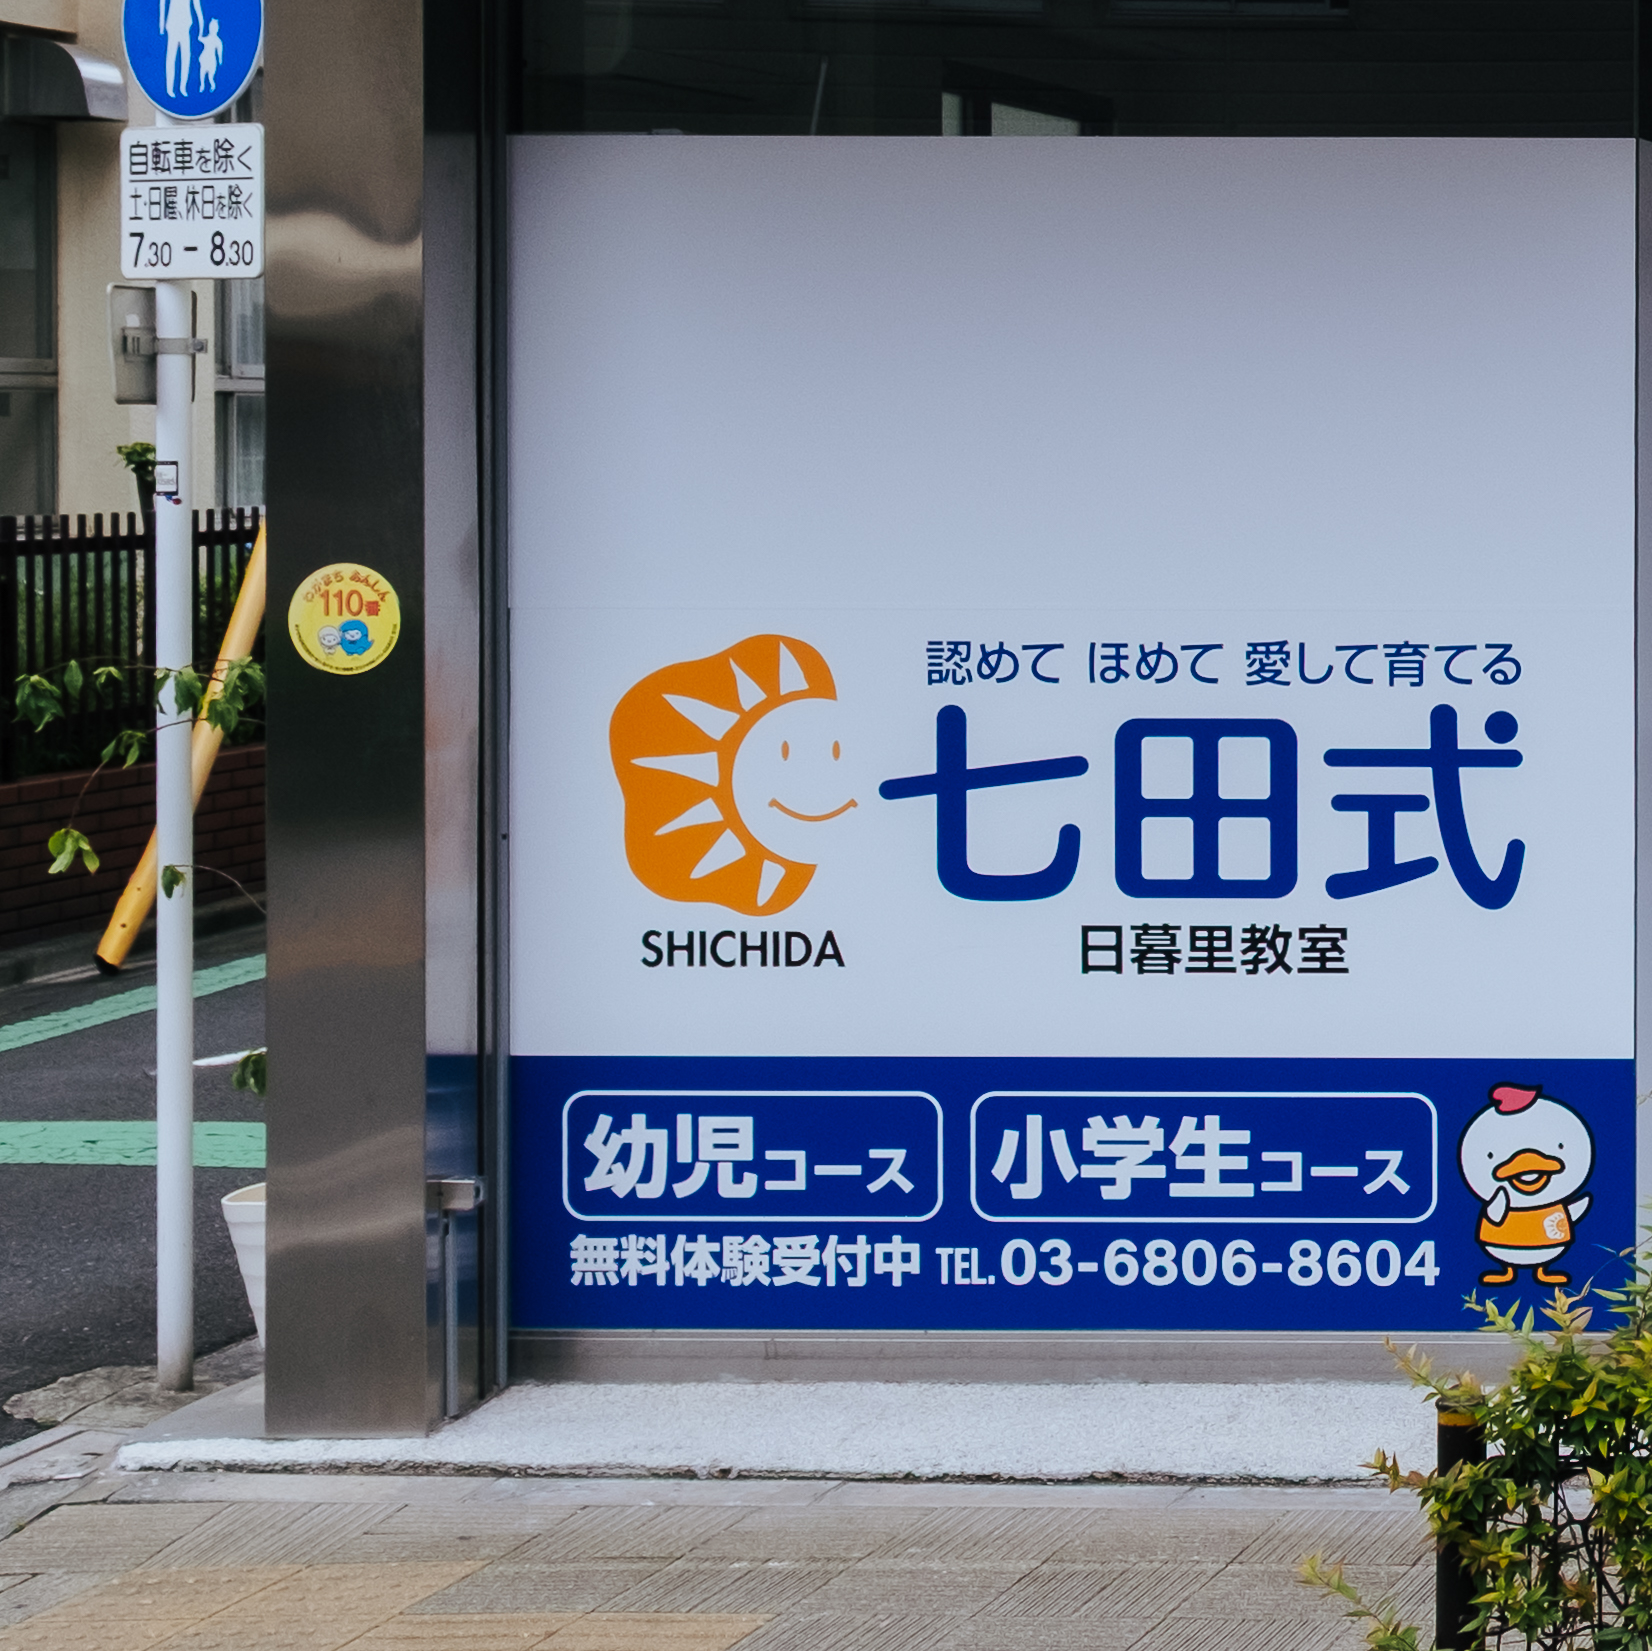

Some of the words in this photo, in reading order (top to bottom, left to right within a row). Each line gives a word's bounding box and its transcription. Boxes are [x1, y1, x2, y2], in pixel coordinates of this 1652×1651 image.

[129, 138, 252, 175] 自転車を除く
[926, 641, 1064, 685] 認めて
[1089, 642, 1223, 684] ほめて
[1246, 640, 1521, 687] 愛して育てる
[879, 704, 1525, 910] 七田式
[642, 930, 845, 967] SHICHIDA
[1082, 923, 1349, 975] 日暮里教室
[584, 1114, 914, 1198] 幼児コース
[991, 1115, 1410, 1200] 小学生コース
[570, 1234, 920, 1287] 無料体験受付中
[1001, 1239, 1440, 1286] 03-6806-8604
